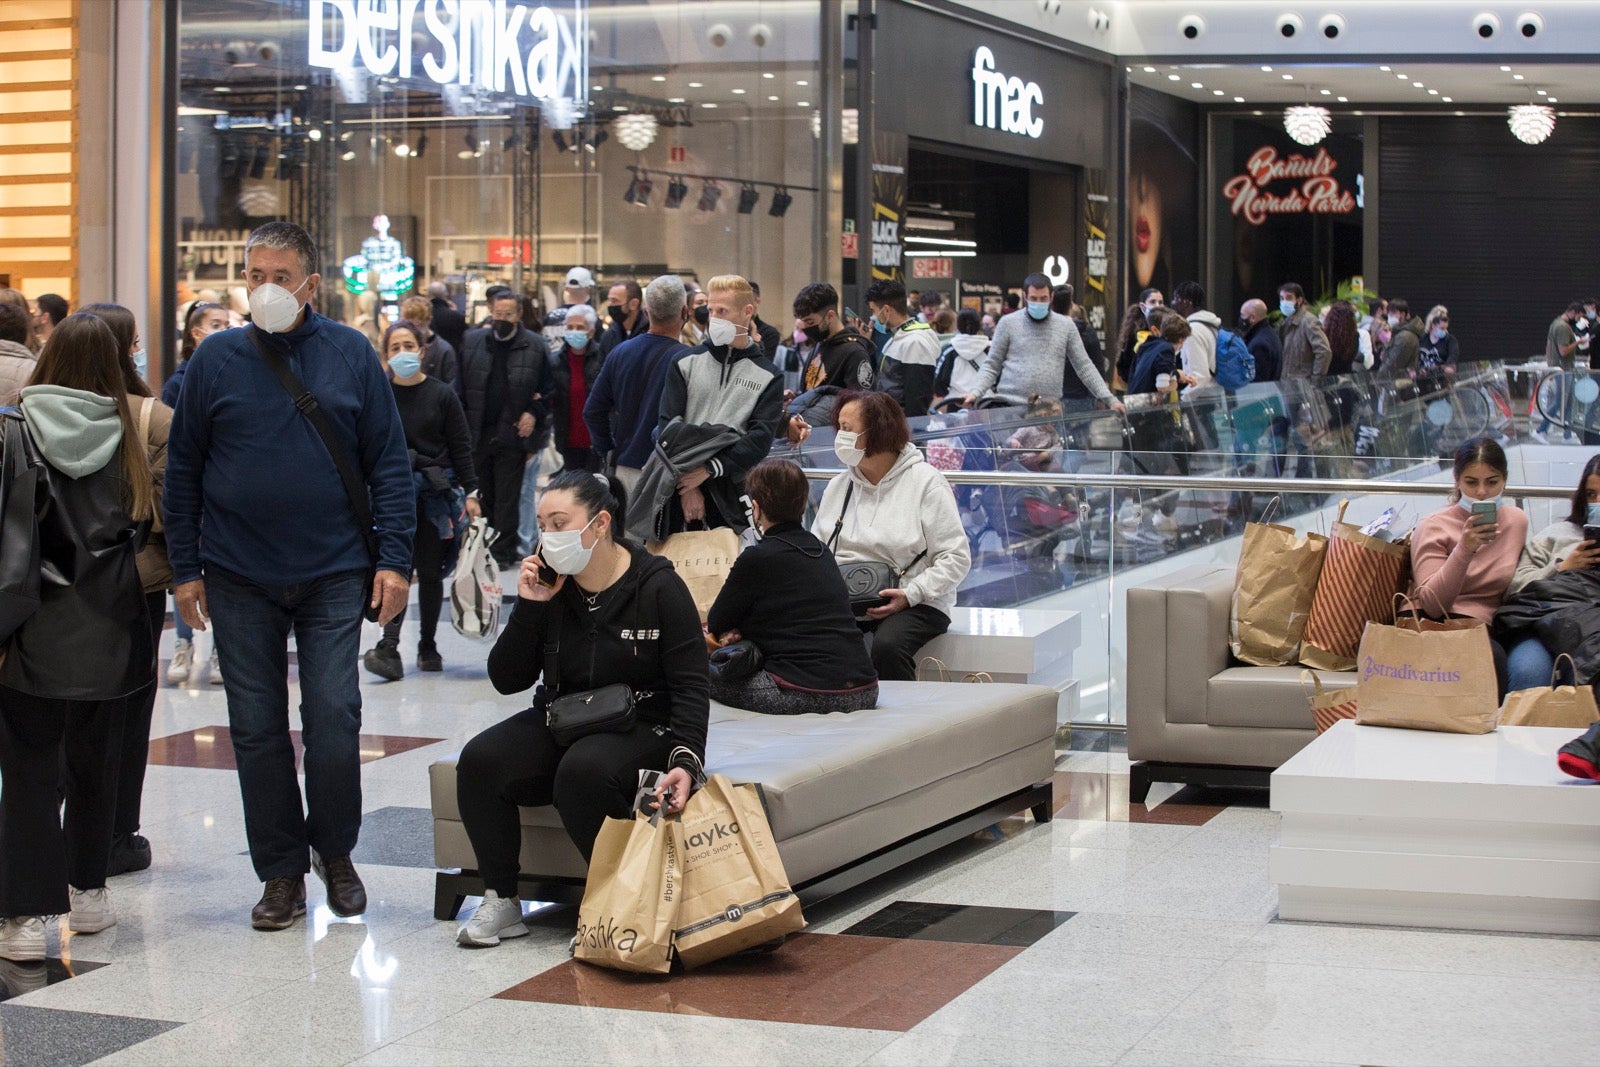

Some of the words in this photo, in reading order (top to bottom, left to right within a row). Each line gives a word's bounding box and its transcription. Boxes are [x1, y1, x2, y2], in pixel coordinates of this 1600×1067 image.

[972, 46, 1044, 138] fnac
[1247, 146, 1337, 186] Bañuls
[1223, 175, 1305, 225] Nevada
[1302, 176, 1355, 213] Park
[1374, 664, 1461, 682] stradivarius
[691, 851, 711, 863] SHOE
[713, 843, 733, 855] SHOP
